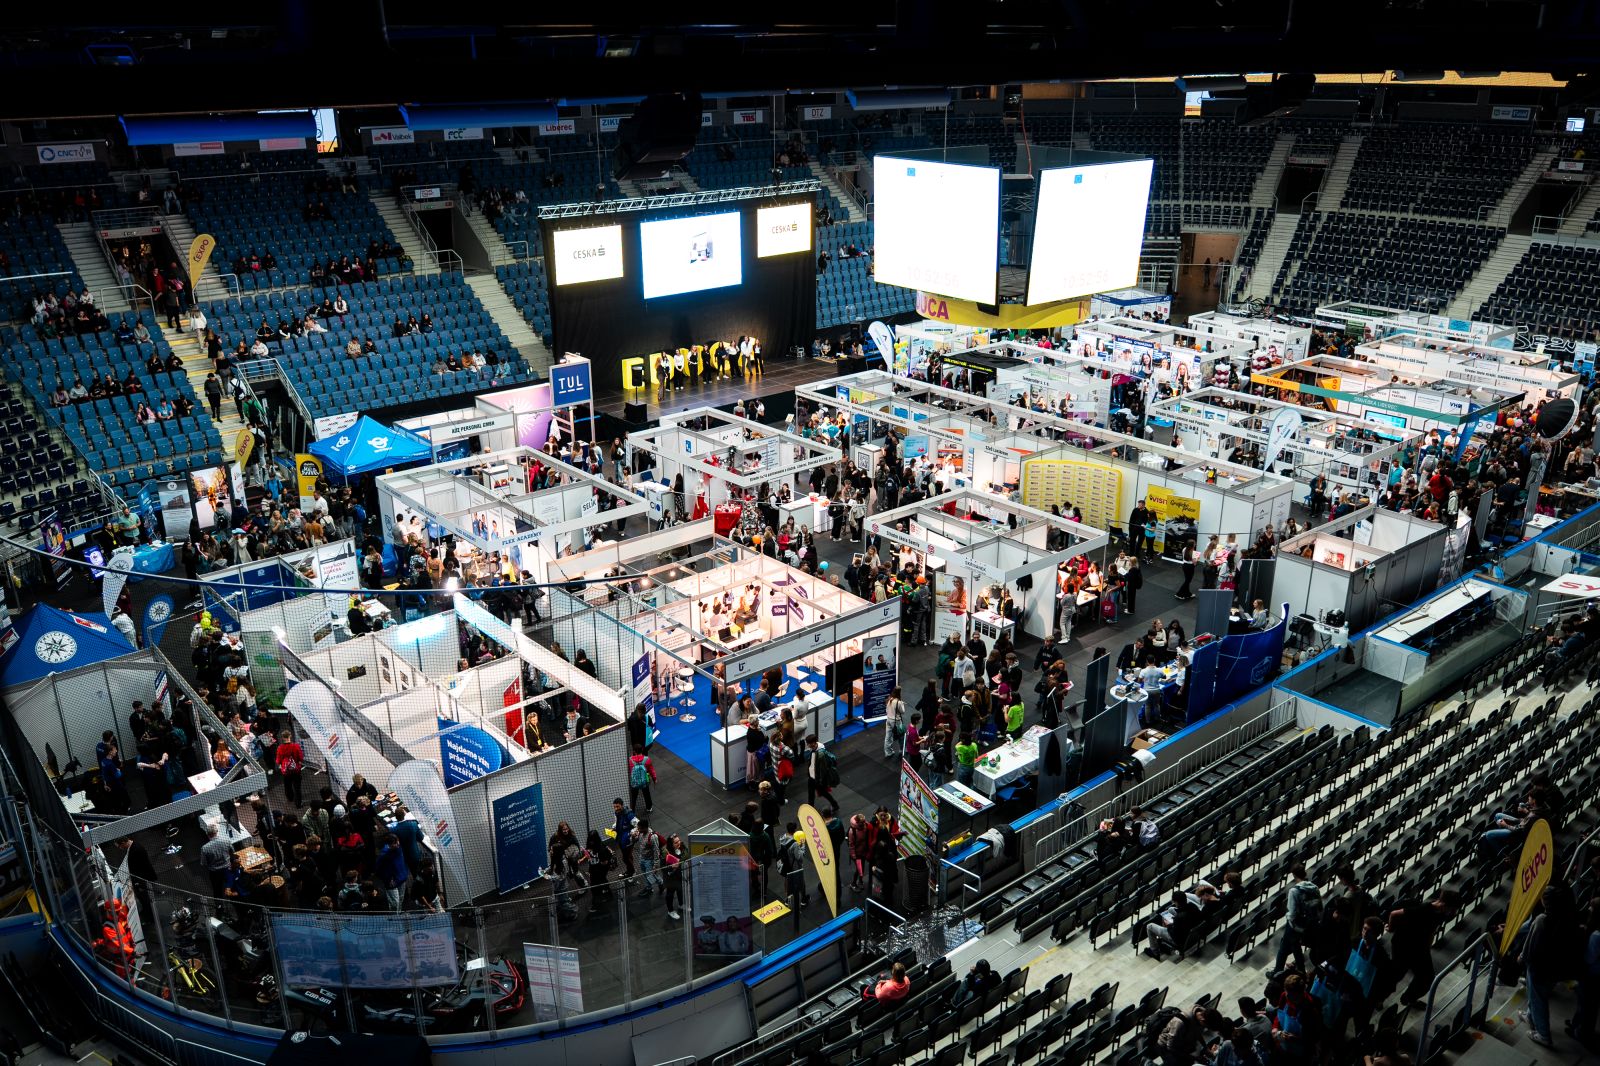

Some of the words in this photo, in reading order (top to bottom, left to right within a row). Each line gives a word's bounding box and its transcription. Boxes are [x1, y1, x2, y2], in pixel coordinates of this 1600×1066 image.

[545, 124, 573, 132] Liberec
[196, 239, 210, 261] EXPO
[558, 375, 584, 390] TUL
[502, 537, 516, 546] FLEX
[517, 531, 542, 542] ACADEMY
[446, 739, 478, 760] Najdeme
[1525, 843, 1548, 889] EXPO
